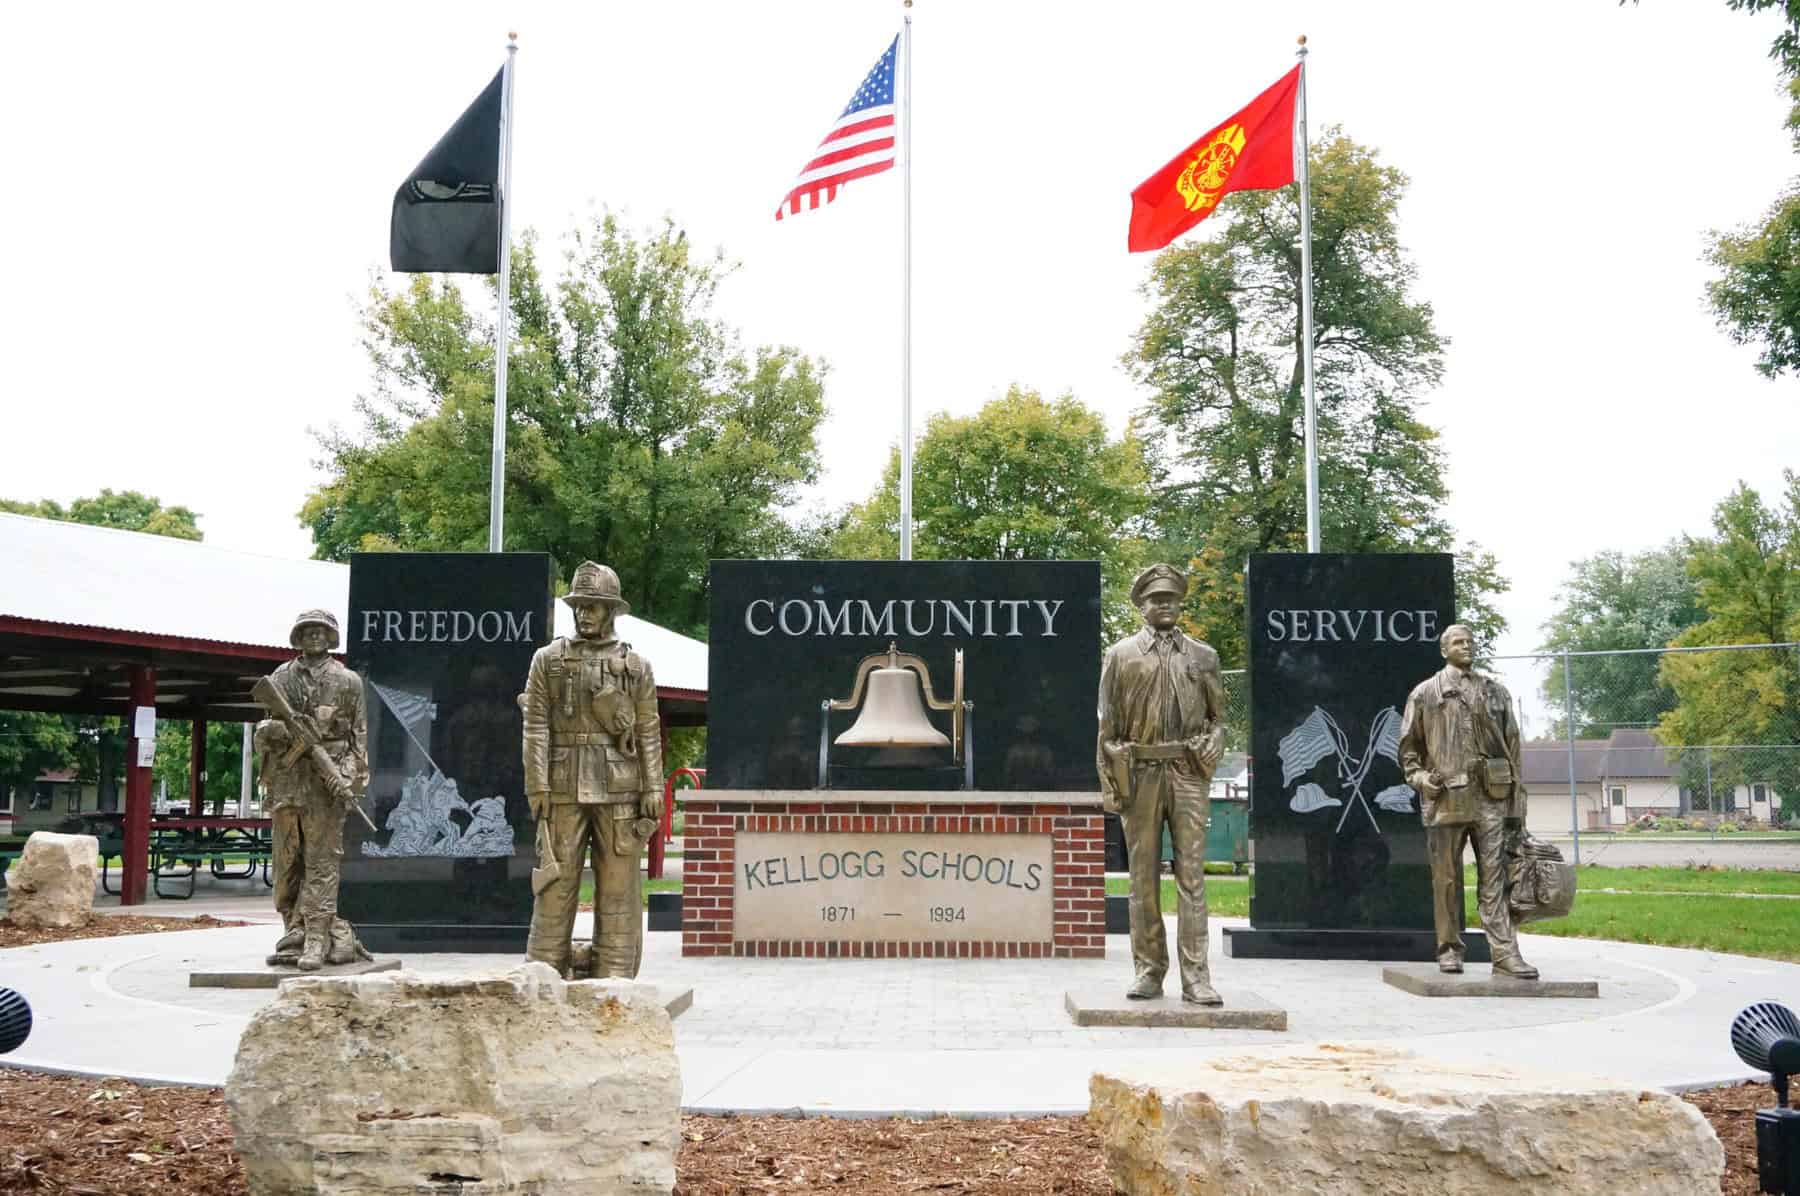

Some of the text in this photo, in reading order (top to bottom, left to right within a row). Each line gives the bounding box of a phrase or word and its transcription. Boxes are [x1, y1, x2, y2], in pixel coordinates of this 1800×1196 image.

[360, 609, 534, 643] FREEDOM
[744, 599, 1065, 638] COMMUNITY
[1267, 608, 1441, 643] SERVICE
[744, 850, 1043, 891] KELLOGG SCHOOLS
[821, 906, 856, 922] 1871
[929, 906, 966, 922] 1994
